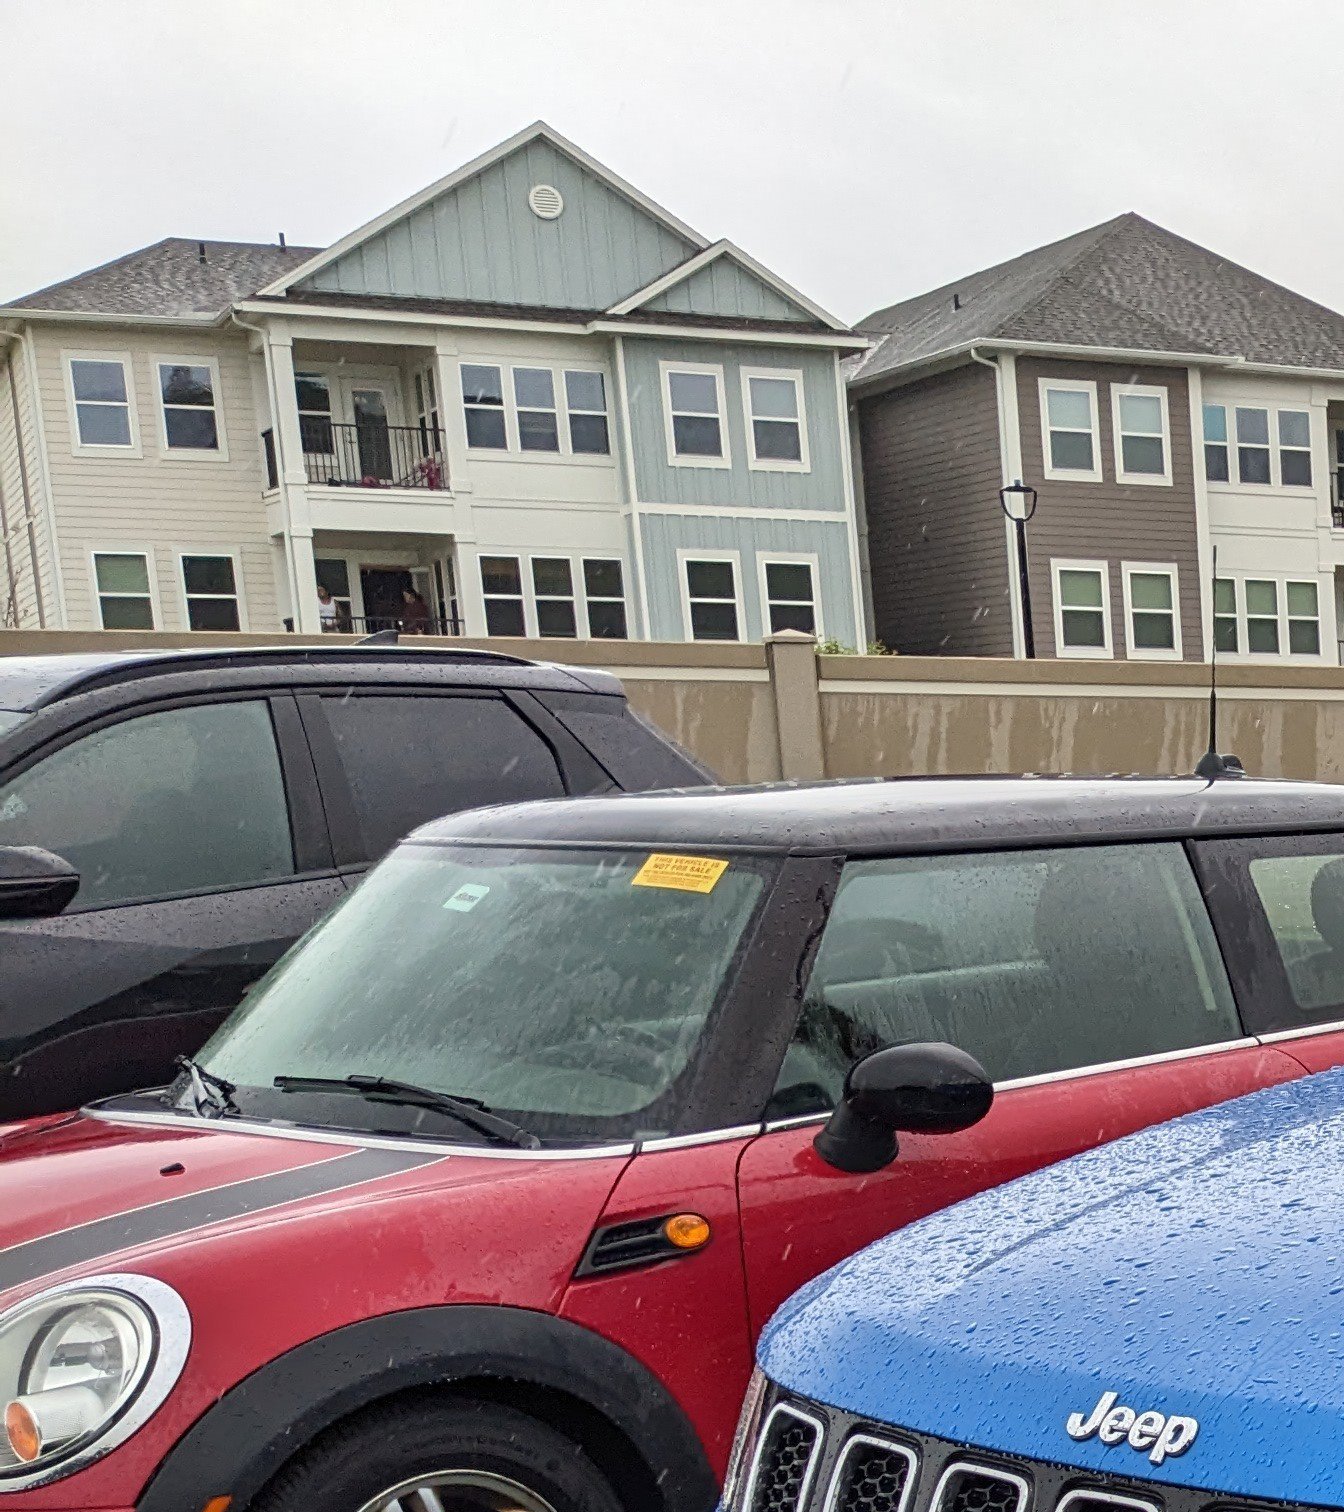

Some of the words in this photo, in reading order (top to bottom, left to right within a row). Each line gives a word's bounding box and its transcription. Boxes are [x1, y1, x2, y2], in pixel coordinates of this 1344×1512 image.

[675, 857, 708, 867] VEHICLE
[671, 864, 688, 872] FOR
[690, 866, 712, 874] SALE
[1066, 1391, 1199, 1465] Jeep
